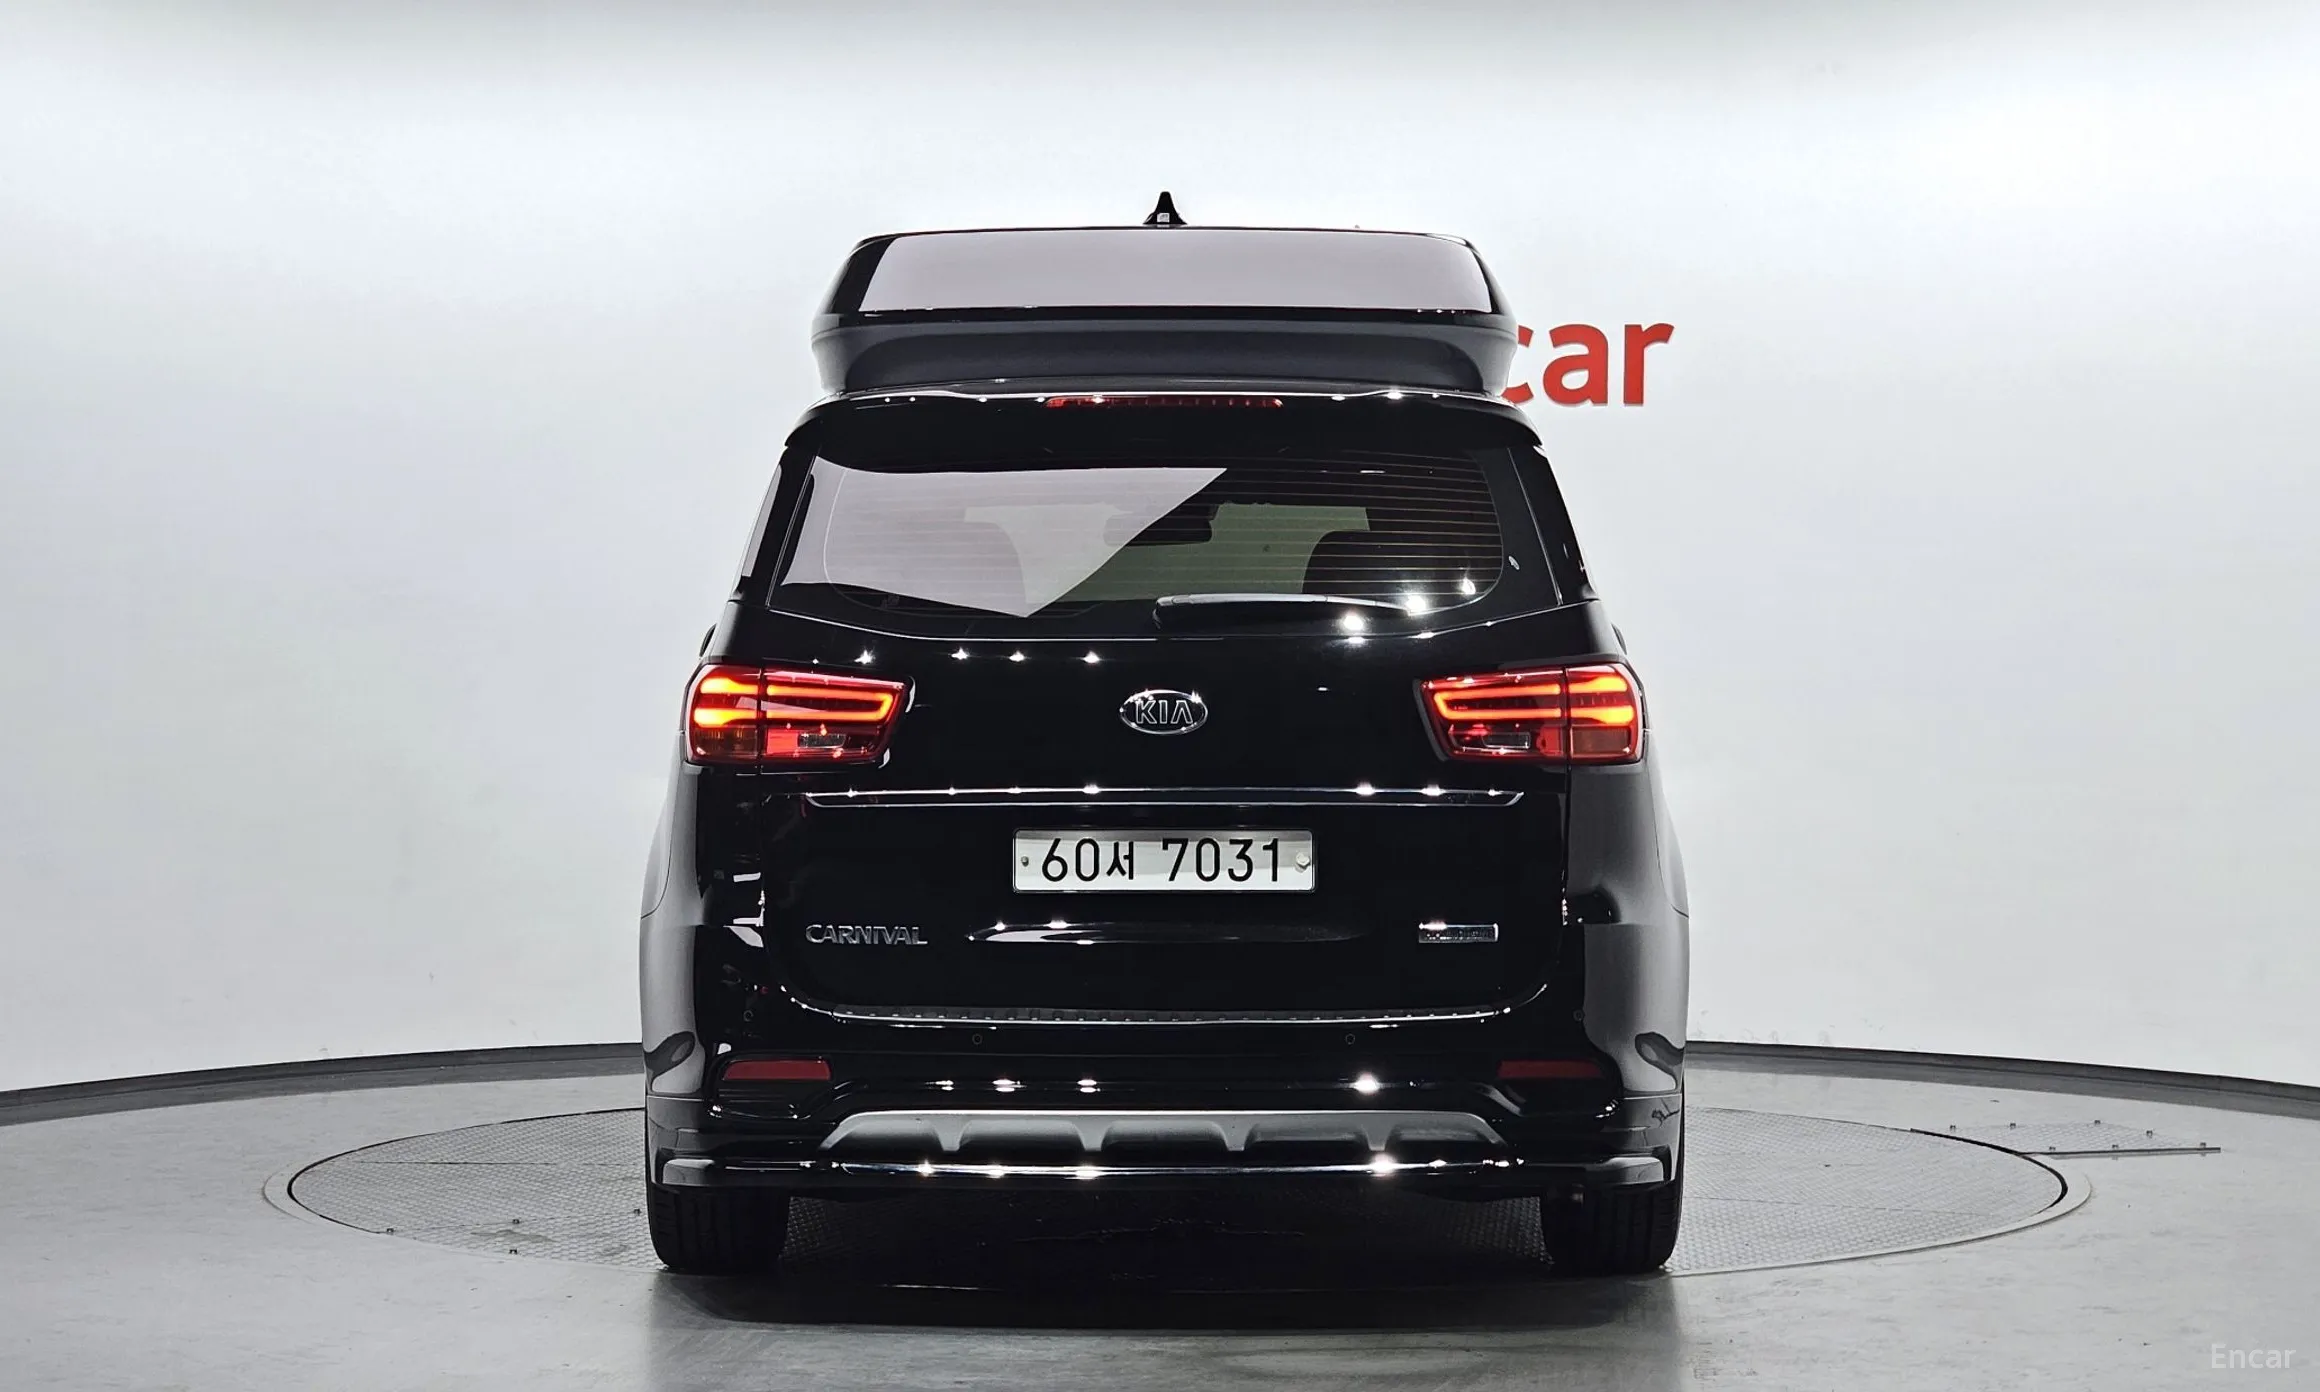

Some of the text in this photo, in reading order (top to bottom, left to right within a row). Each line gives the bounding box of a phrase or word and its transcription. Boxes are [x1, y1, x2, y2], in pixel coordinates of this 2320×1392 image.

[1135, 699, 1194, 725] KIA
[1041, 837, 1279, 882] 60서 7031
[805, 924, 929, 945] CARNIVAL
